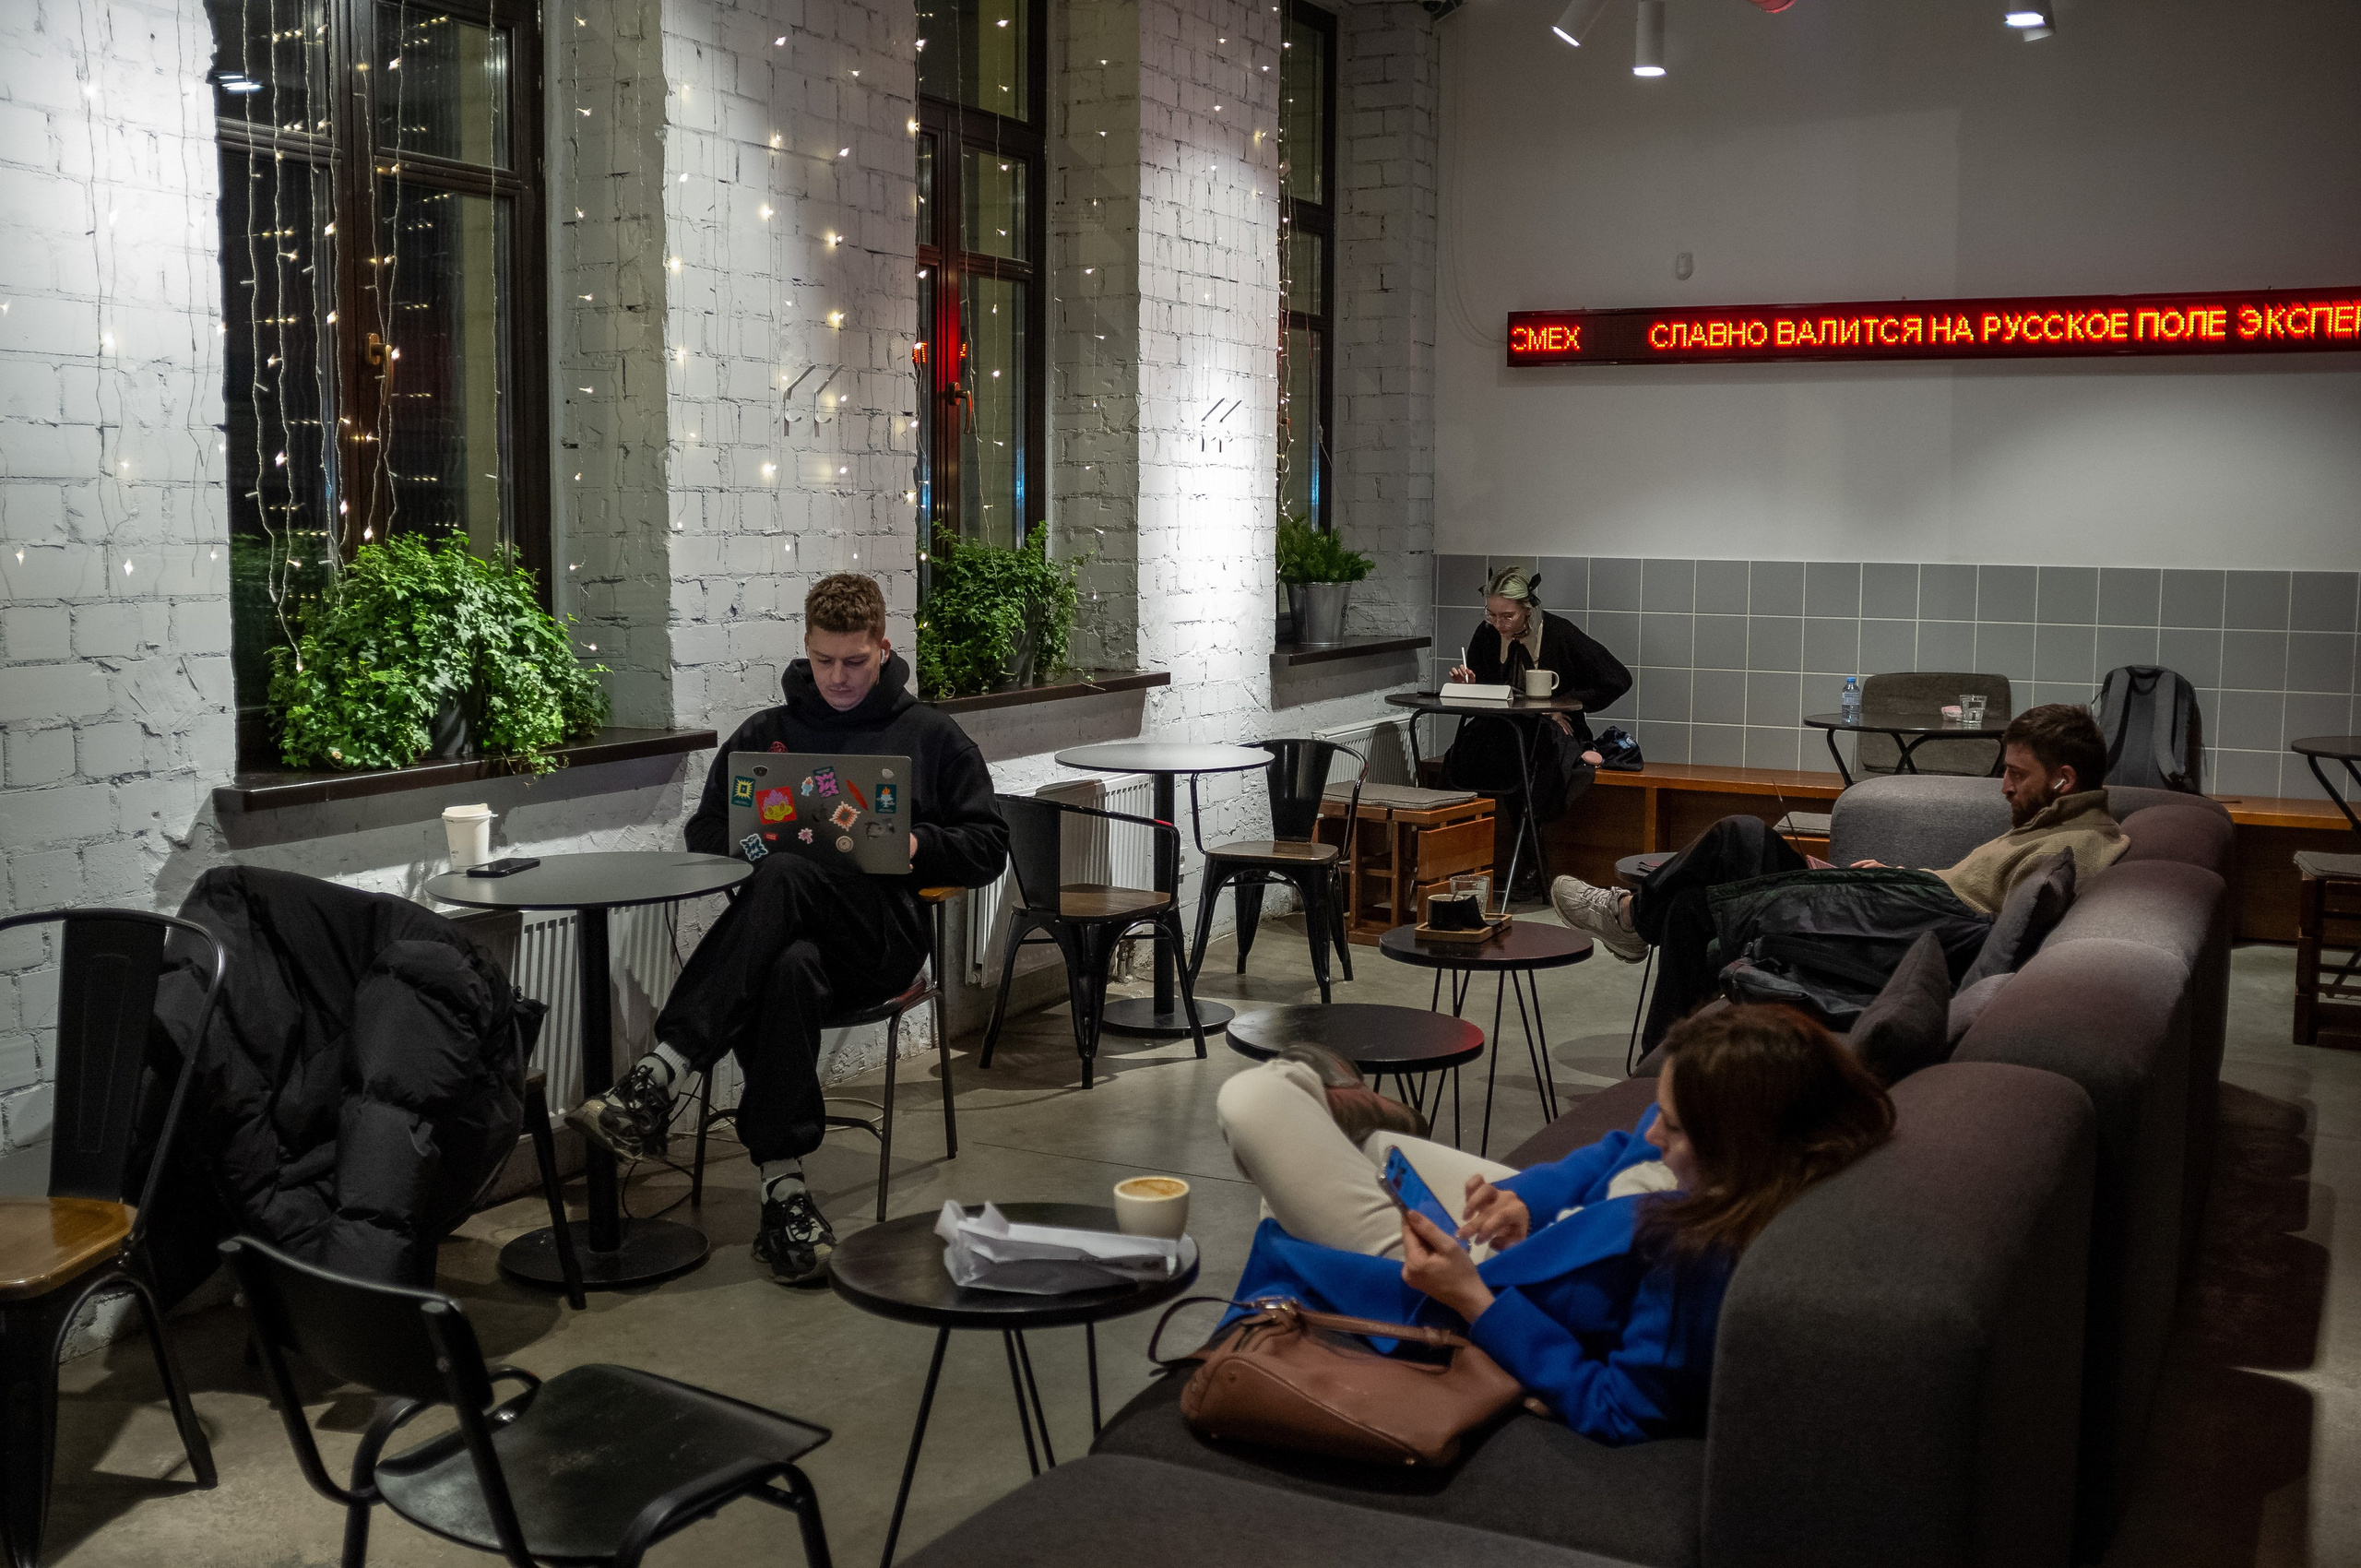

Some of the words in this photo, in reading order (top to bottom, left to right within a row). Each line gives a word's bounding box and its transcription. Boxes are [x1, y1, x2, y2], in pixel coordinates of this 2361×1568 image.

[1513, 326, 1581, 351] СМЕХ
[1650, 320, 1769, 349] СЛАВНО
[1775, 315, 1923, 346] ВАЛИТСЯ
[1930, 315, 1975, 343] НА
[1983, 311, 2130, 342] РУССКОЕ
[2137, 308, 2228, 340] ПОЛЕ
